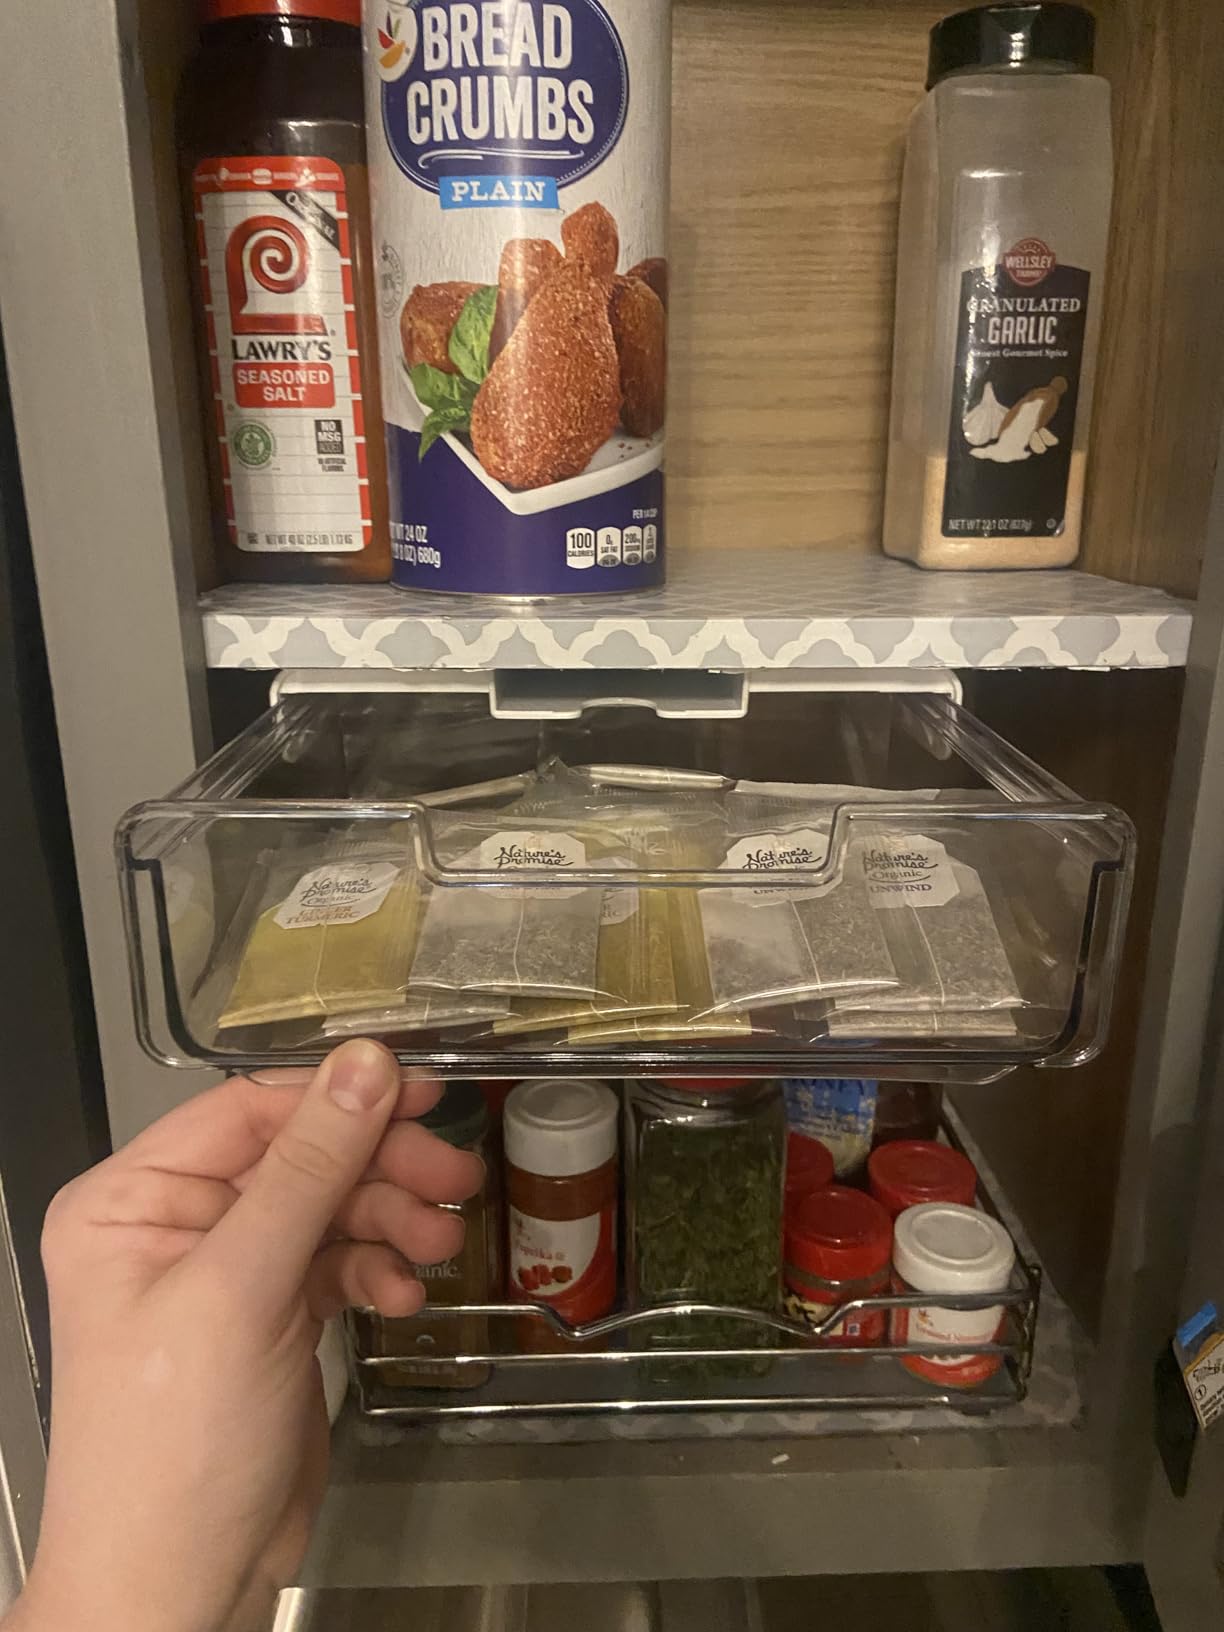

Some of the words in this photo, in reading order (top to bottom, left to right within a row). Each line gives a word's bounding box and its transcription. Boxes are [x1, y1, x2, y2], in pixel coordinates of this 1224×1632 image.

[421, 2, 574, 72] BREAD
[406, 75, 595, 146] CRUMBS
[451, 181, 546, 202] PLAIN
[1004, 255, 1053, 269] WELLSLEY
[988, 316, 1058, 345] GARLIC
[231, 339, 332, 361] LAWRY'S
[236, 368, 331, 385] SEASONED
[262, 386, 307, 402] SALT
[320, 420, 337, 432] NO
[317, 431, 342, 442] MSG
[949, 519, 965, 530] NET
[966, 519, 980, 530] WT
[997, 519, 1009, 530] OZ
[404, 524, 415, 542] 24
[415, 525, 428, 543] OZ
[570, 532, 593, 549] 100
[418, 546, 441, 568] 680g
[499, 844, 566, 859] Nature's
[745, 847, 813, 864] Nature's
[863, 850, 929, 864] Nature's
[494, 855, 575, 869] Promise
[864, 860, 939, 873] Promise
[872, 870, 922, 882] Organic
[312, 877, 373, 893] Nature's
[869, 883, 933, 893] UNWIND
[299, 885, 377, 902] Promise
